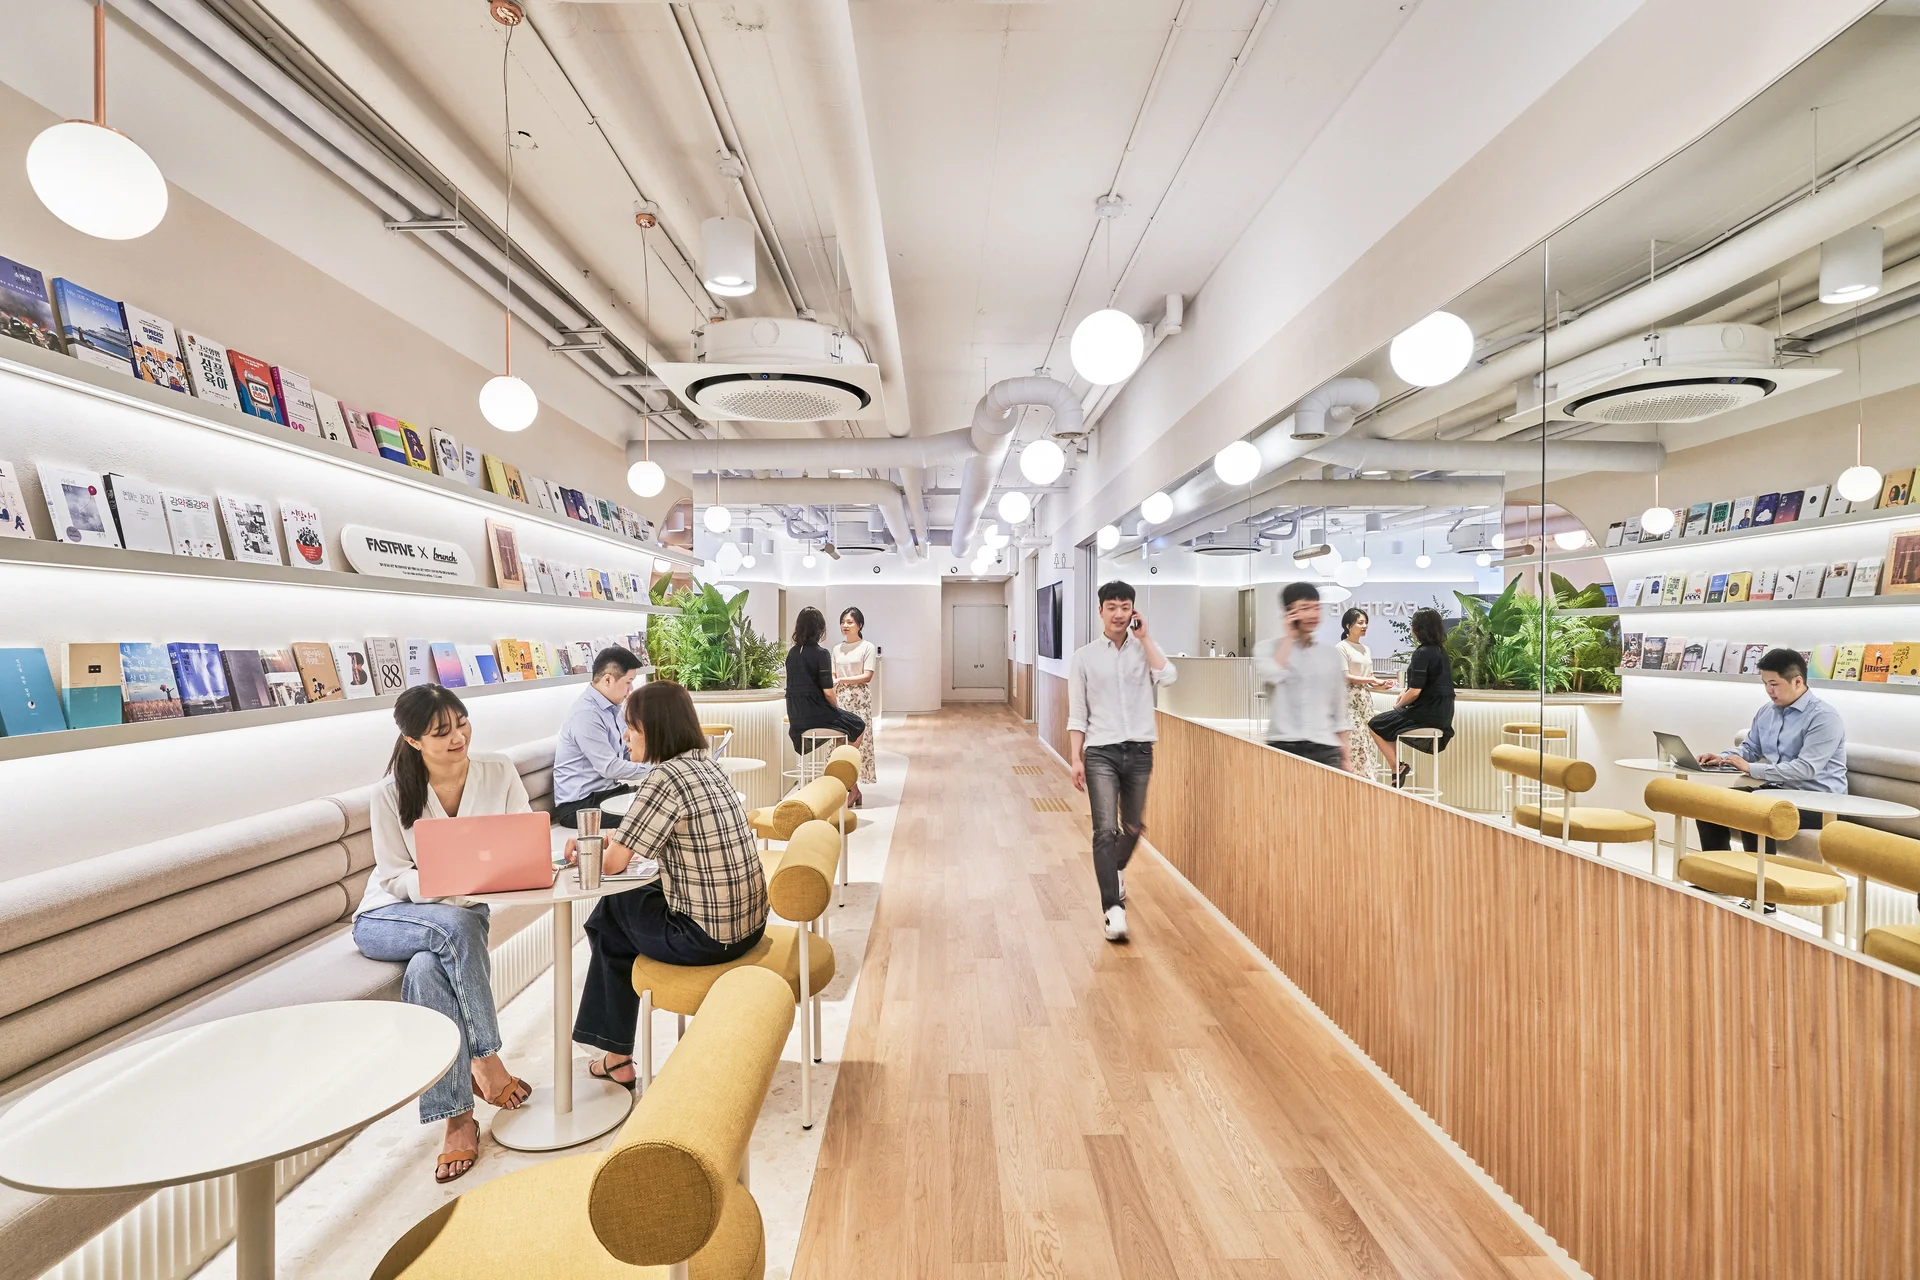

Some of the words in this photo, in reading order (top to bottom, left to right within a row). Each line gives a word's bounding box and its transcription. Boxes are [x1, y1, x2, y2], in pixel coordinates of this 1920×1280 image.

[204, 372, 228, 390] 육아
[170, 496, 209, 510] 강약중강약
[365, 537, 416, 557] FASTFIVE
[433, 547, 458, 564] brunch
[382, 664, 402, 688] 88
